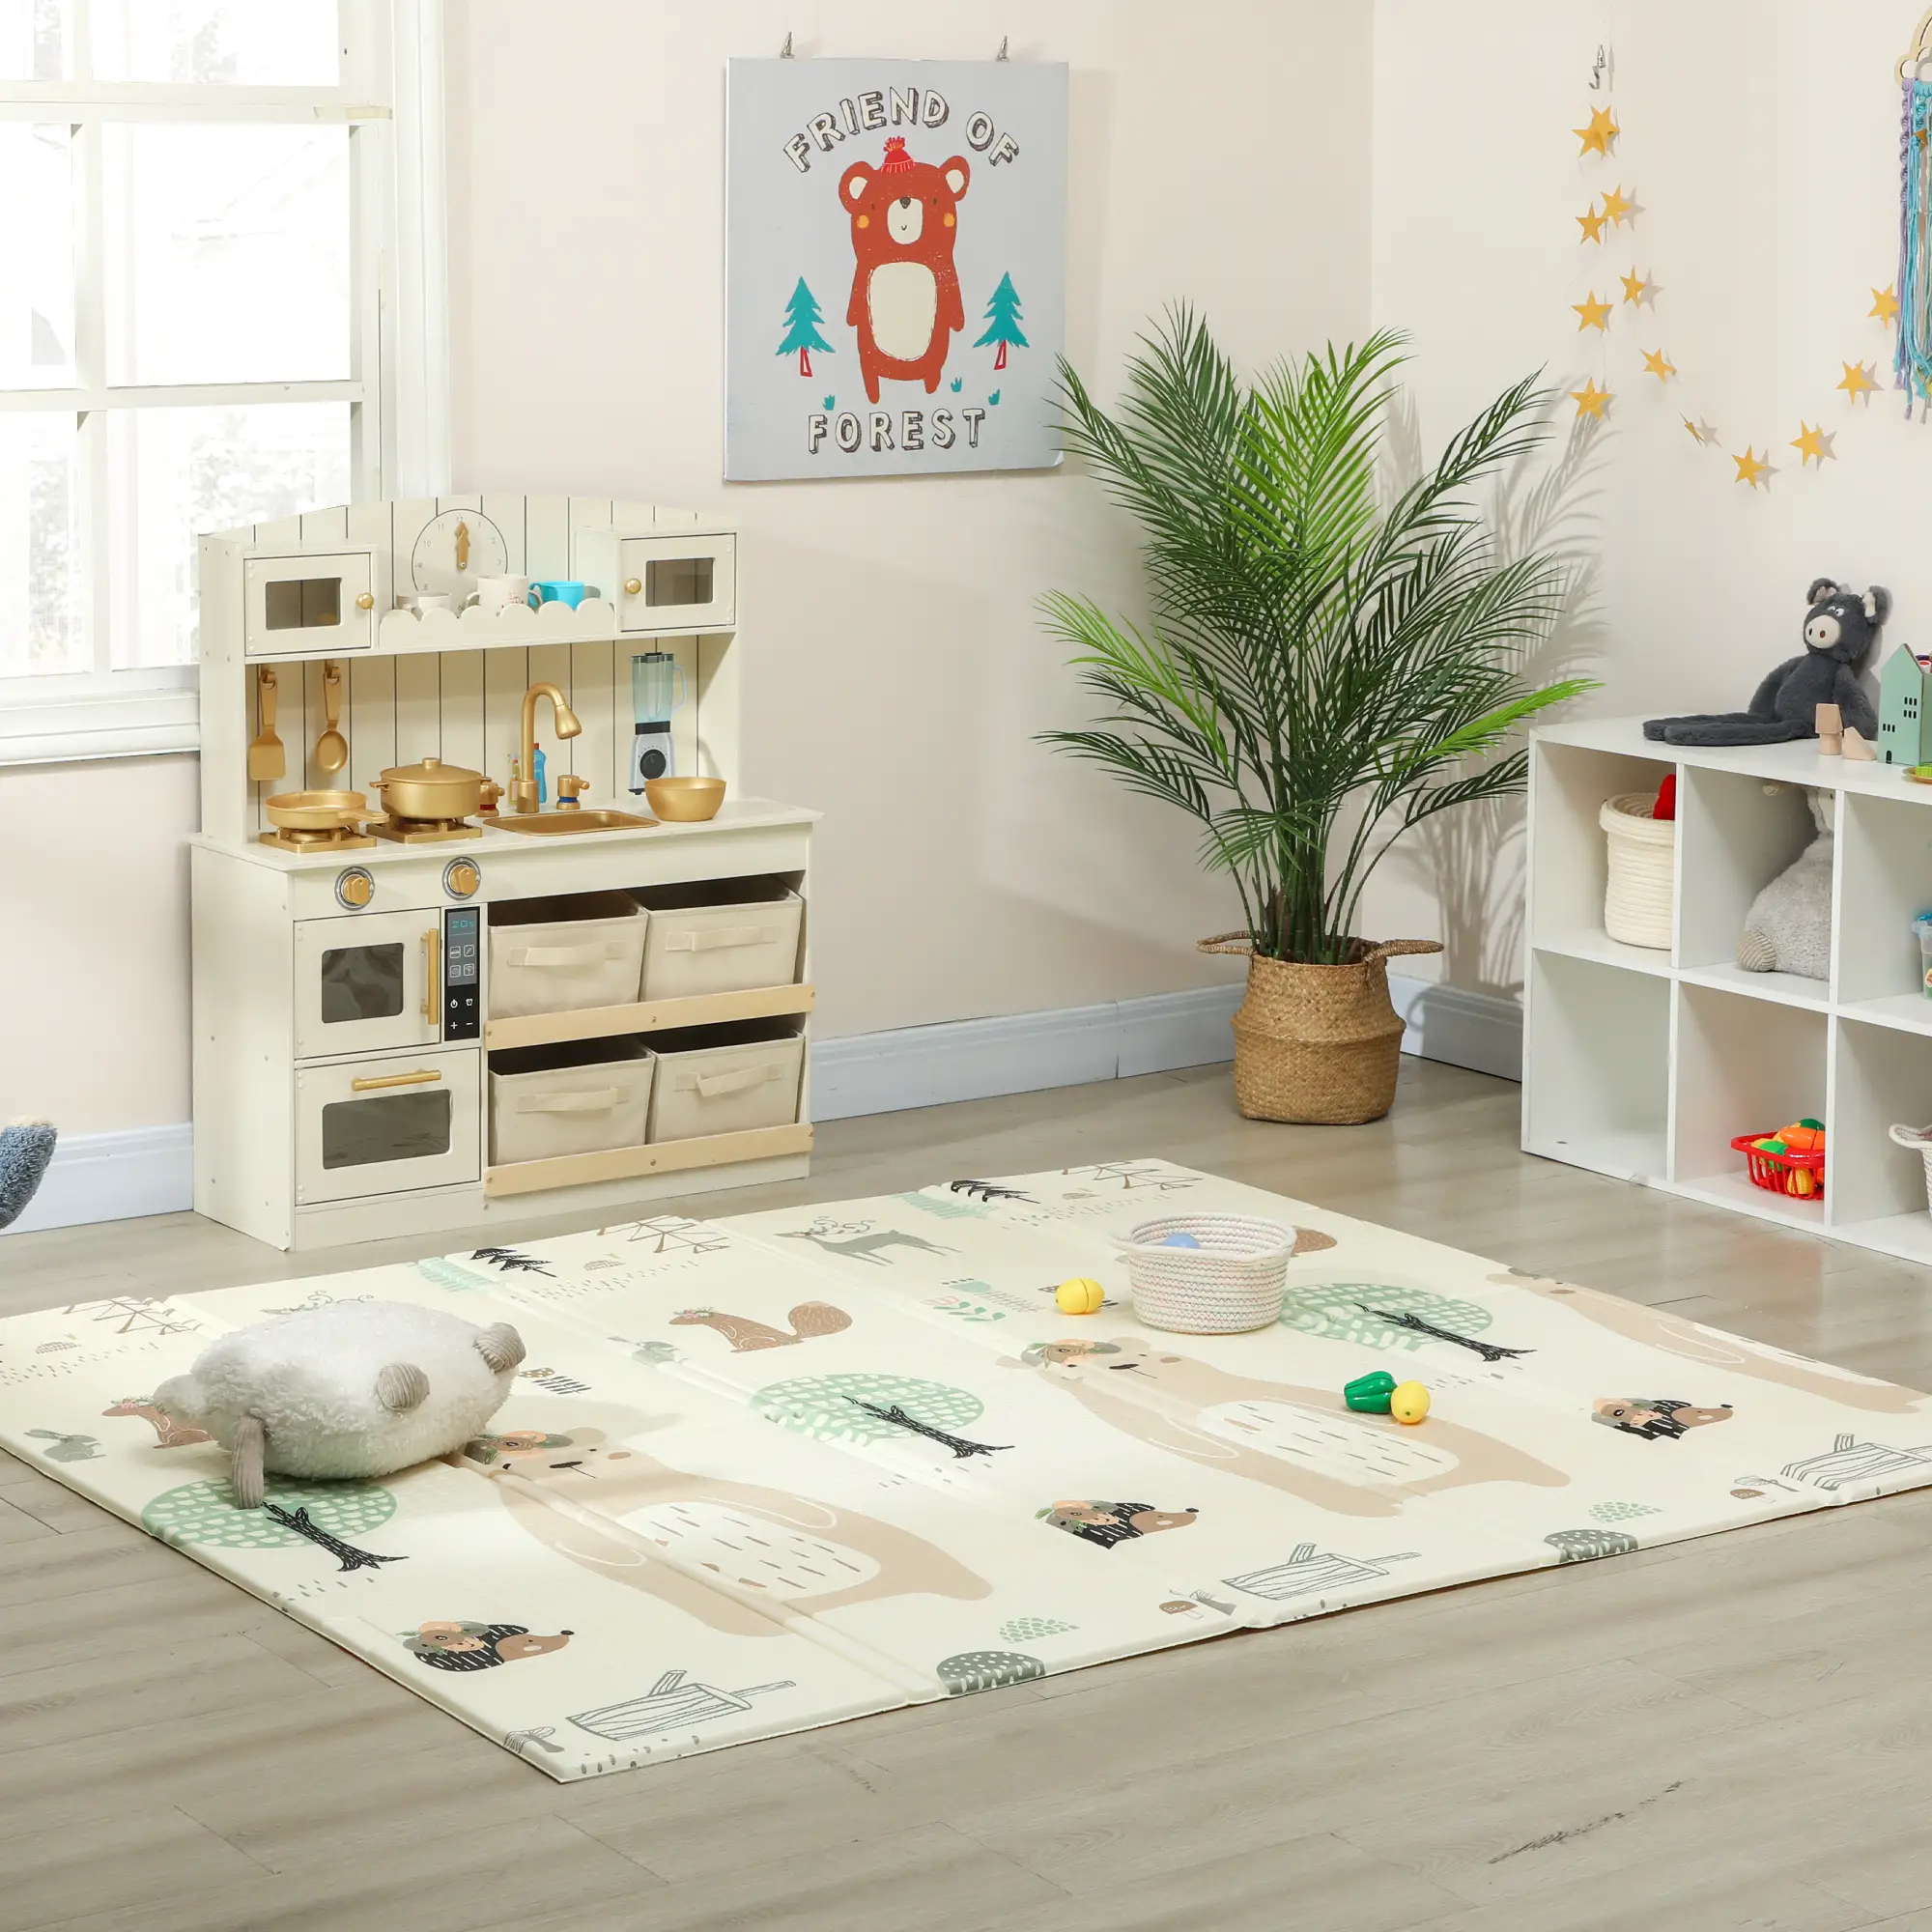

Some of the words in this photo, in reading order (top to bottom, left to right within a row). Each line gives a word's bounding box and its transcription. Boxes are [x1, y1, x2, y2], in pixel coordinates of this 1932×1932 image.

[782, 86, 949, 173] FRIEND
[966, 111, 1019, 166] OF
[809, 408, 985, 453] FOREST
[423, 539, 431, 548] 10
